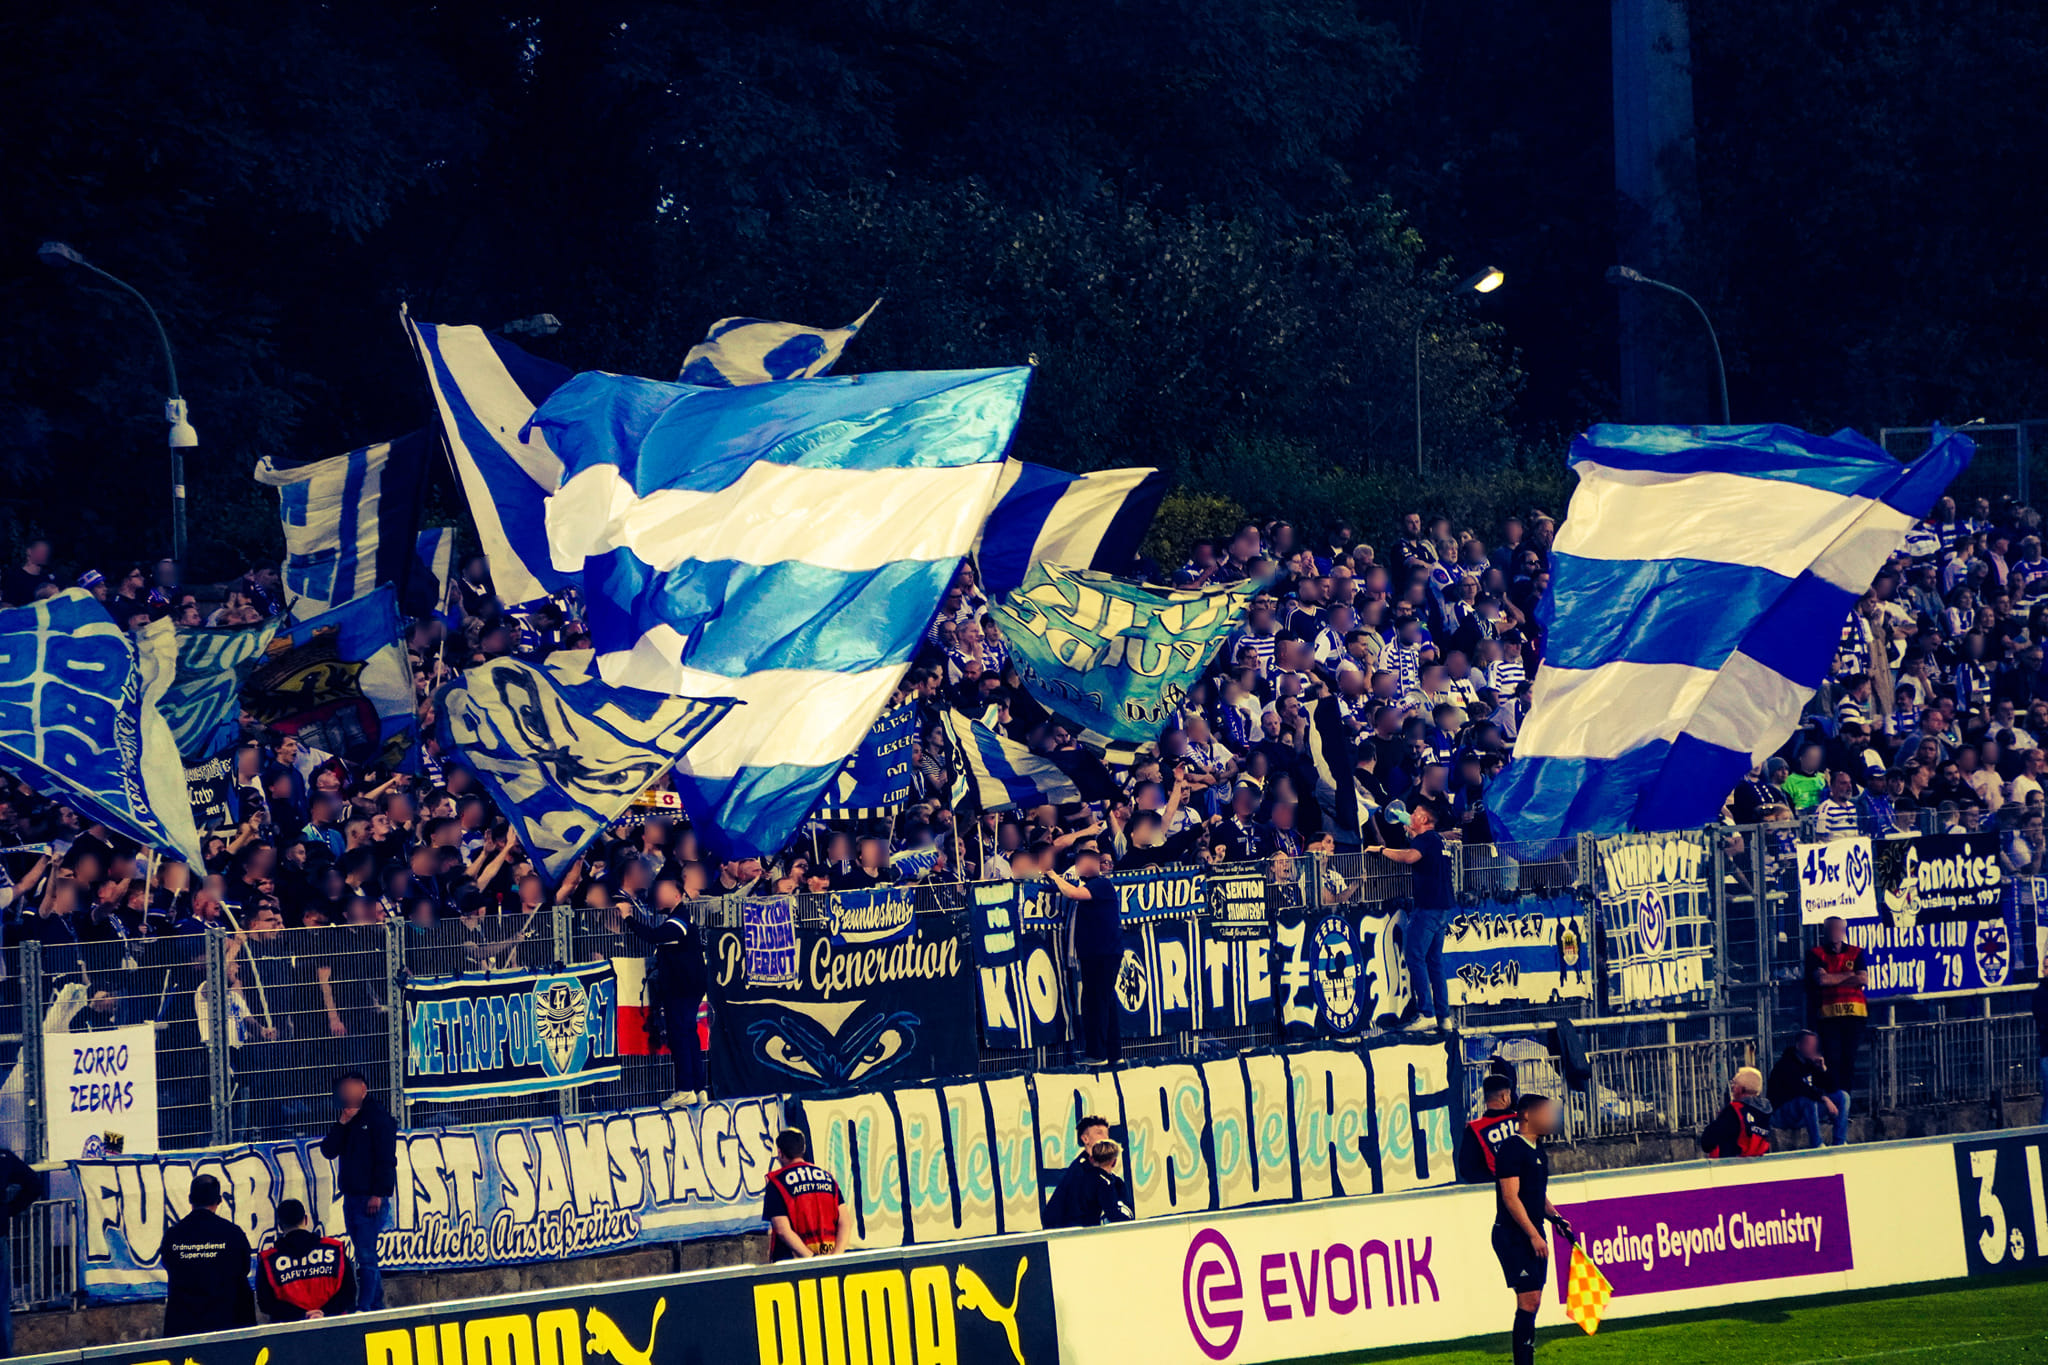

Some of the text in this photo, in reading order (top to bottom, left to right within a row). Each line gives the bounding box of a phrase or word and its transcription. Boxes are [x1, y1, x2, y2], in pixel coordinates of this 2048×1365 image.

[1802, 847, 1840, 886] 45er
[1225, 880, 1264, 899] SEKTION
[830, 893, 914, 937] Freundeskreis
[1848, 922, 1925, 955] upporters
[810, 929, 961, 999] Generation
[1866, 953, 1925, 993] uisburg
[406, 977, 616, 1076] METROPOL 47
[73, 1044, 128, 1076] ZORRO
[69, 1081, 134, 1114] ZEBRAS
[172, 1242, 226, 1252] Ordnungsdienst
[180, 1251, 218, 1259] Supervisor
[1656, 1214, 1726, 1267] Beyond
[1729, 1209, 1822, 1252] Chemistry
[1260, 1236, 1440, 1322] EVONIK
[753, 1264, 957, 1365] PUMA
